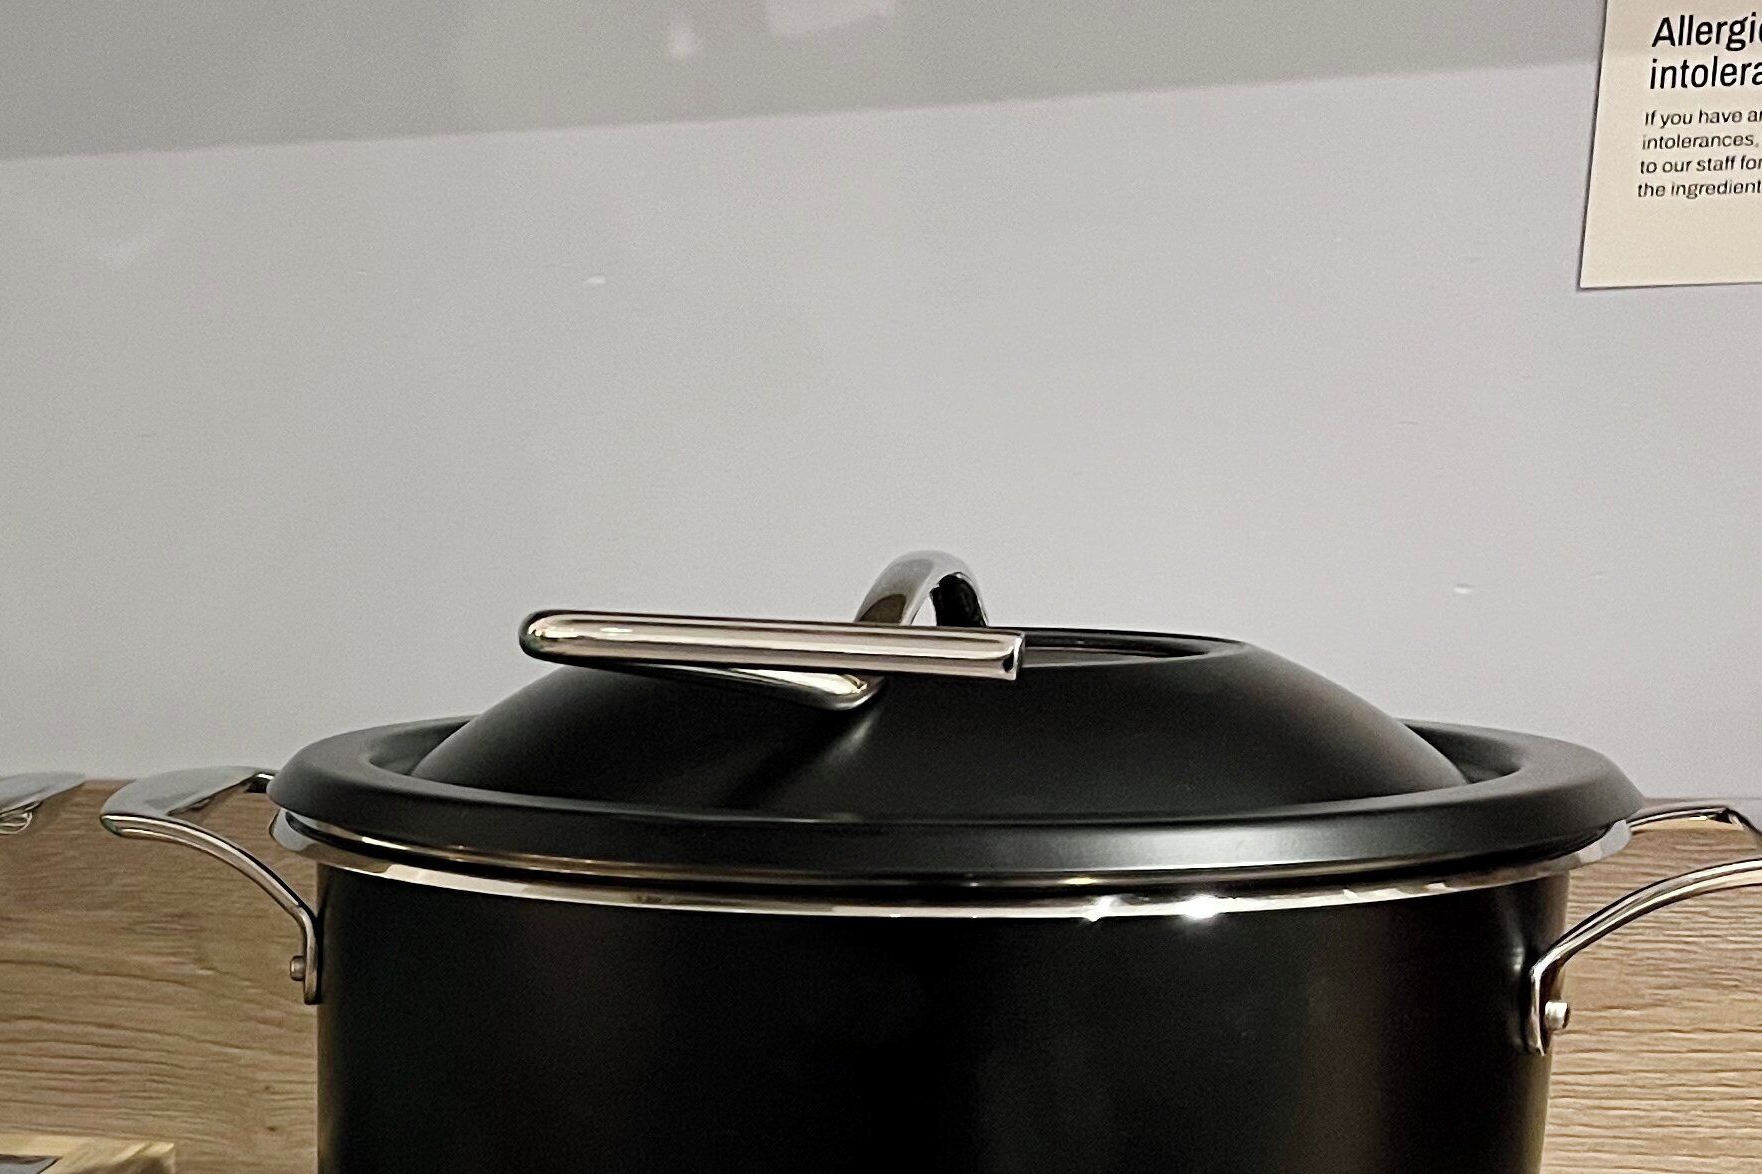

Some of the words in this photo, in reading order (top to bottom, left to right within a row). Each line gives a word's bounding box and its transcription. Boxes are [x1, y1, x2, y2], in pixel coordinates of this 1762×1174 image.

[1651, 11, 1762, 52] Allergi
[1645, 109, 1657, 126] If
[1660, 113, 1693, 130] you
[1698, 109, 1743, 124] have
[1640, 160, 1658, 175] to
[1662, 160, 1693, 174] our
[1696, 155, 1737, 172] staff
[1638, 182, 1666, 198] the
